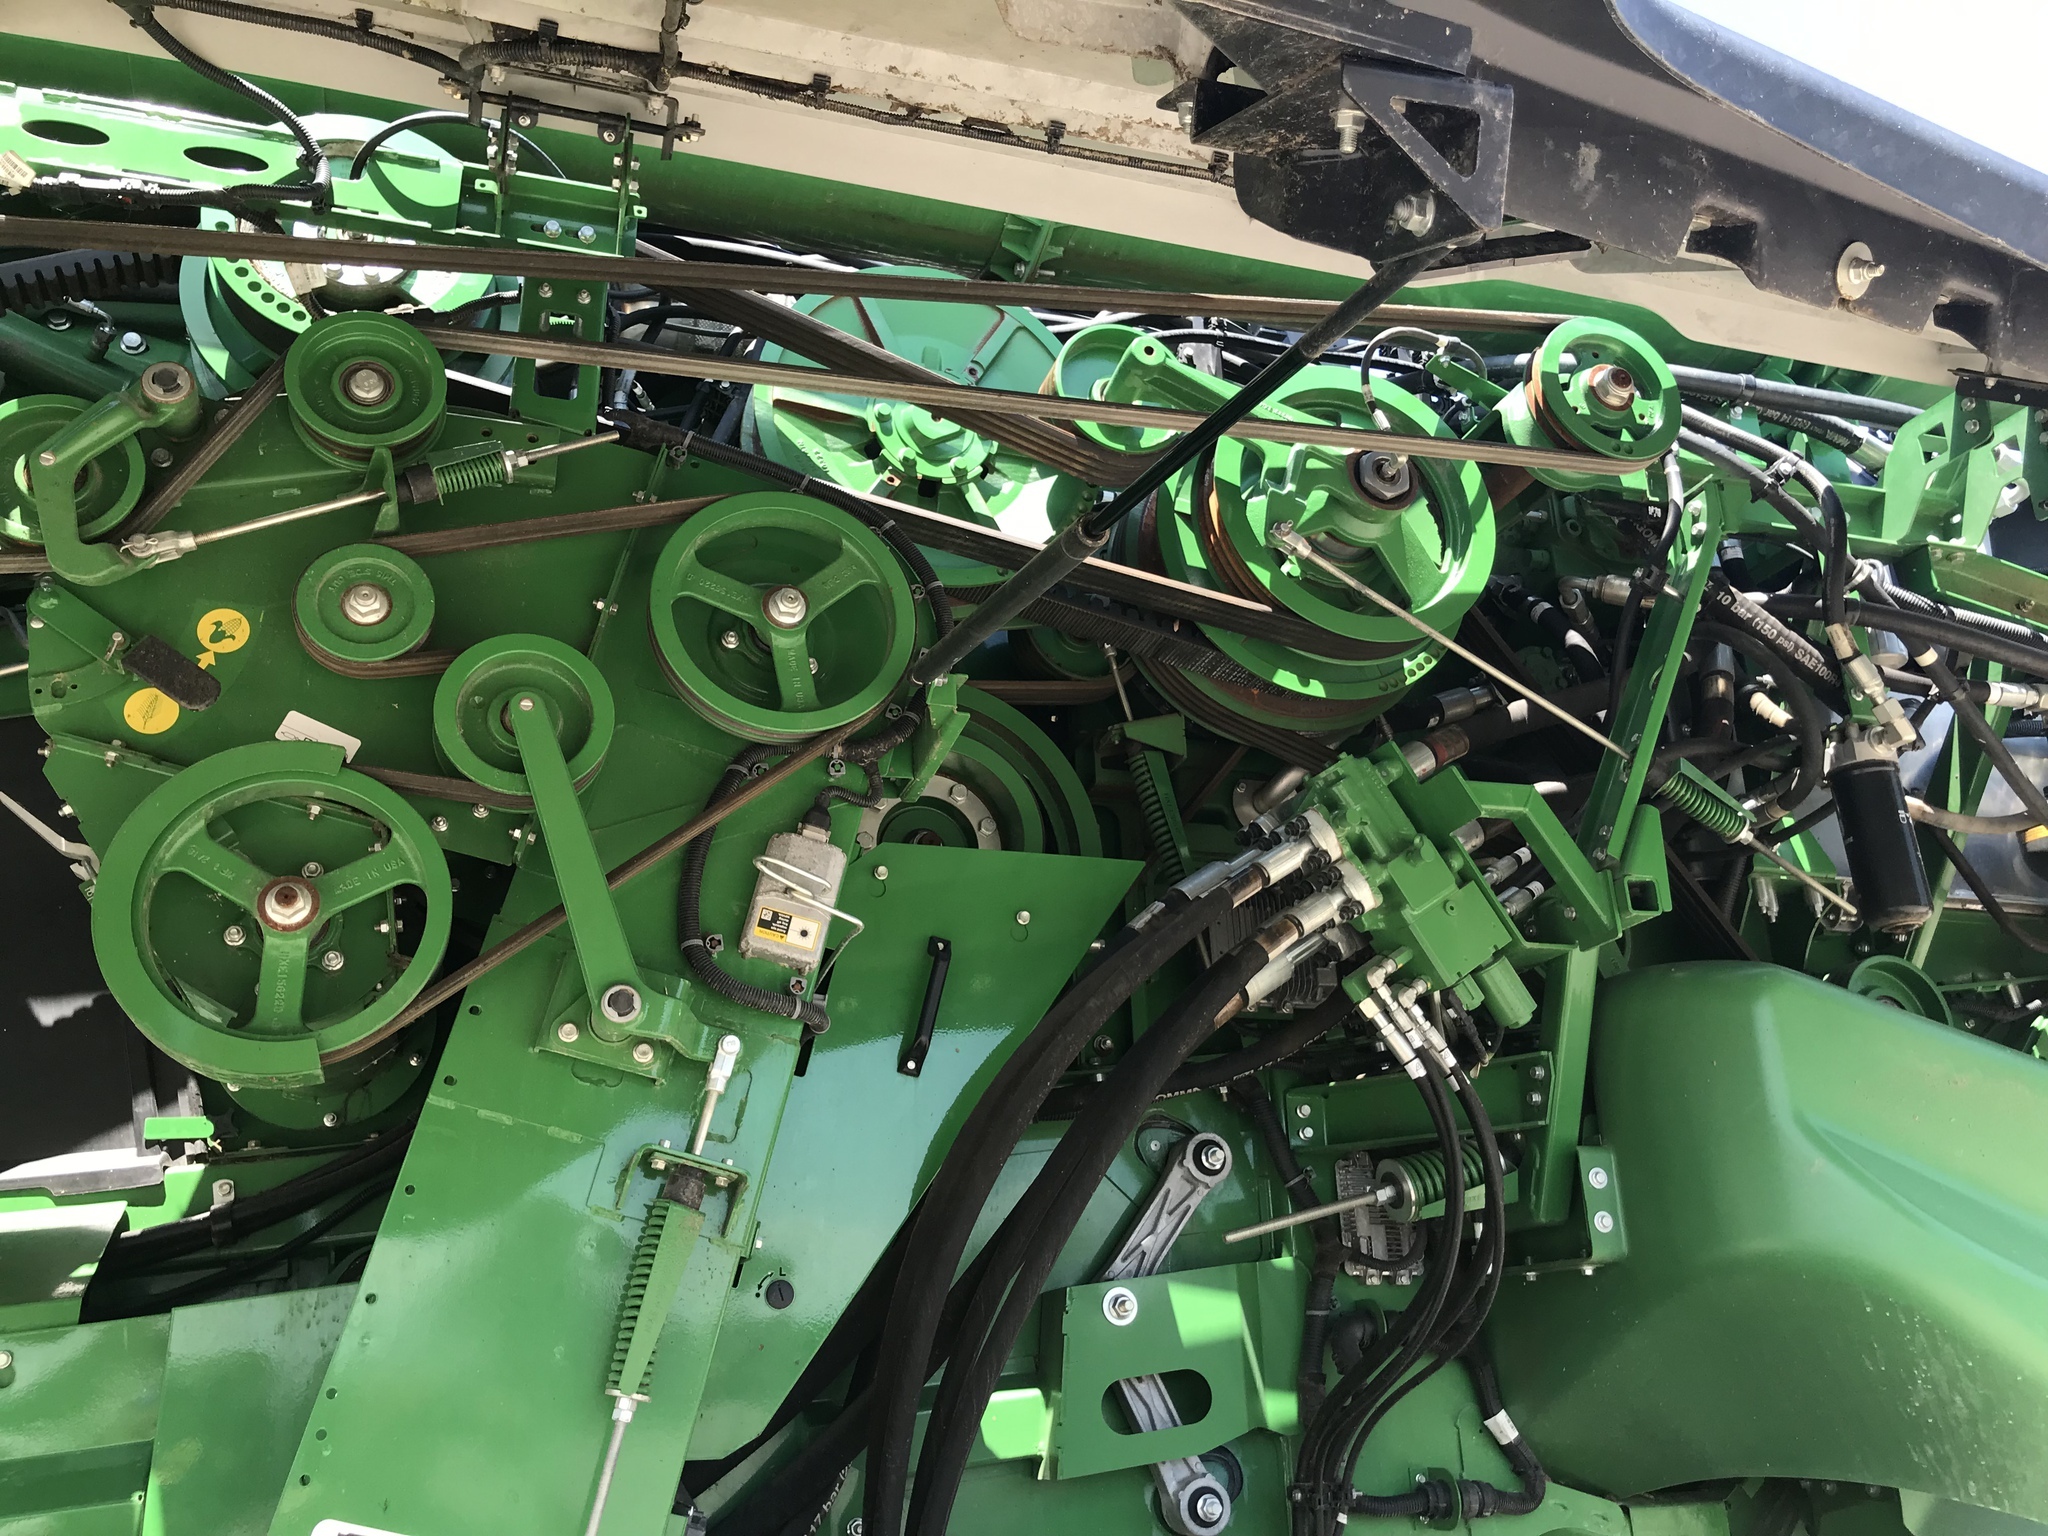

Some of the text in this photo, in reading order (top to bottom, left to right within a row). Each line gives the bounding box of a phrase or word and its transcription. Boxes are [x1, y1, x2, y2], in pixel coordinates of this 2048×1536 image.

[1716, 591, 1733, 606] 10
[1730, 602, 1753, 621] bar
[1752, 617, 1778, 640] (150
[1775, 636, 1796, 653] psi)
[334, 858, 406, 895] MADE IN USA
[779, 1266, 787, 1277] L
